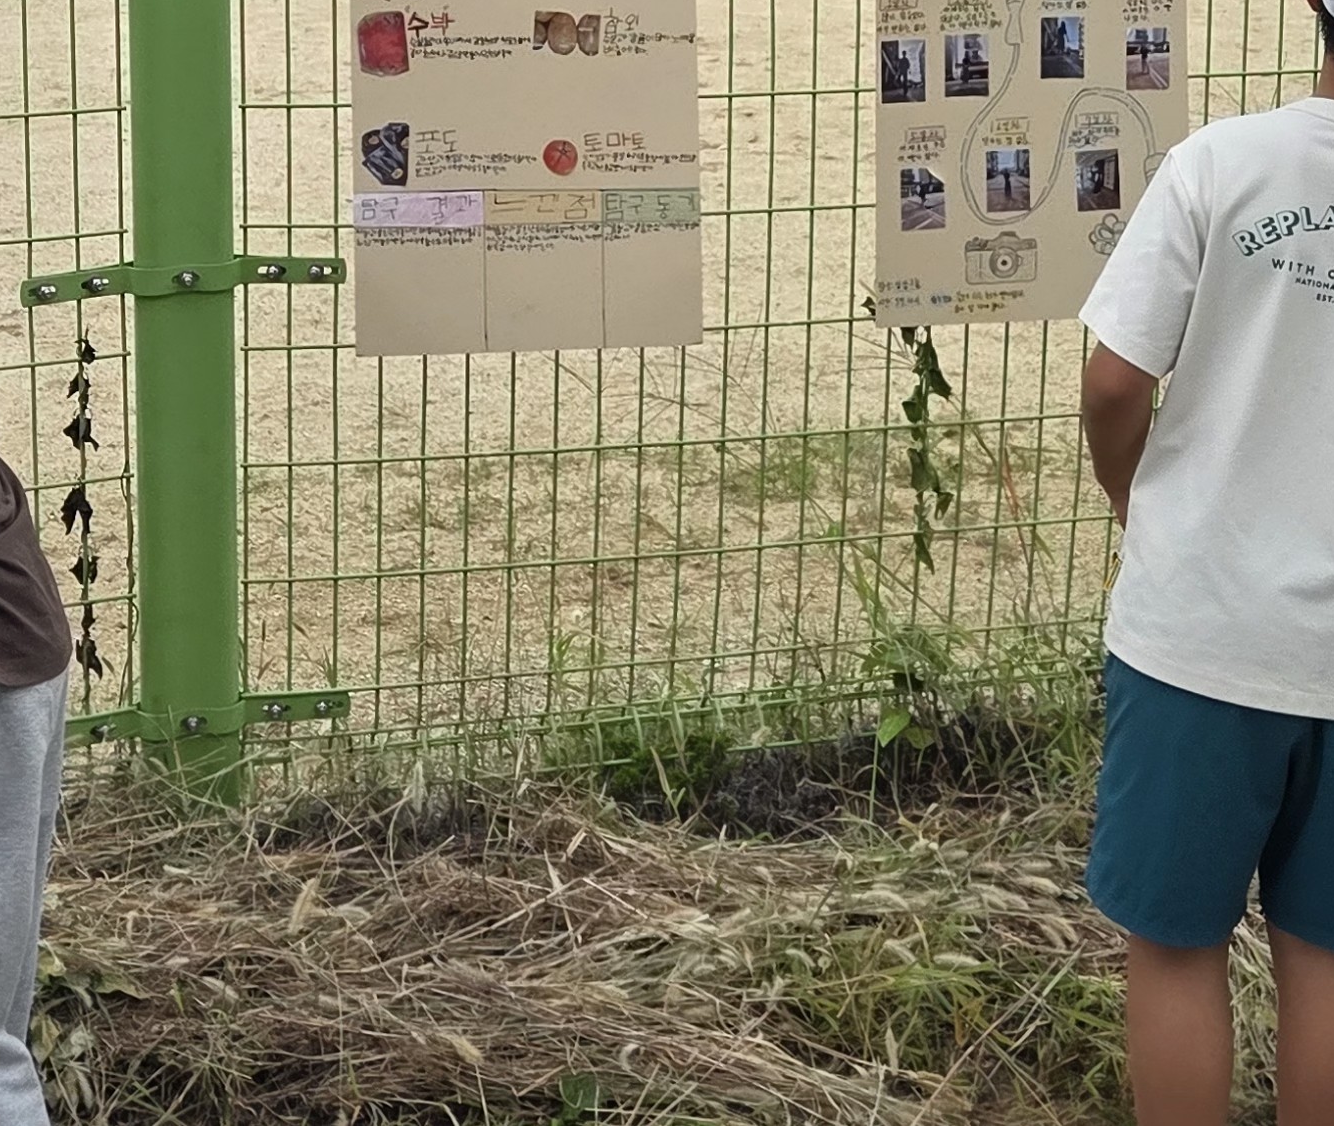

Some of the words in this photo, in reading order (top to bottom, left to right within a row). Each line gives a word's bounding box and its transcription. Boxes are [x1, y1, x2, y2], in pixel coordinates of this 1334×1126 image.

[407, 11, 456, 39] 수박
[415, 130, 458, 154] 포도
[584, 132, 647, 152] 토마토
[361, 196, 398, 221] 탐구
[605, 193, 645, 222] 탐구
[1271, 258, 1315, 276] WITH
